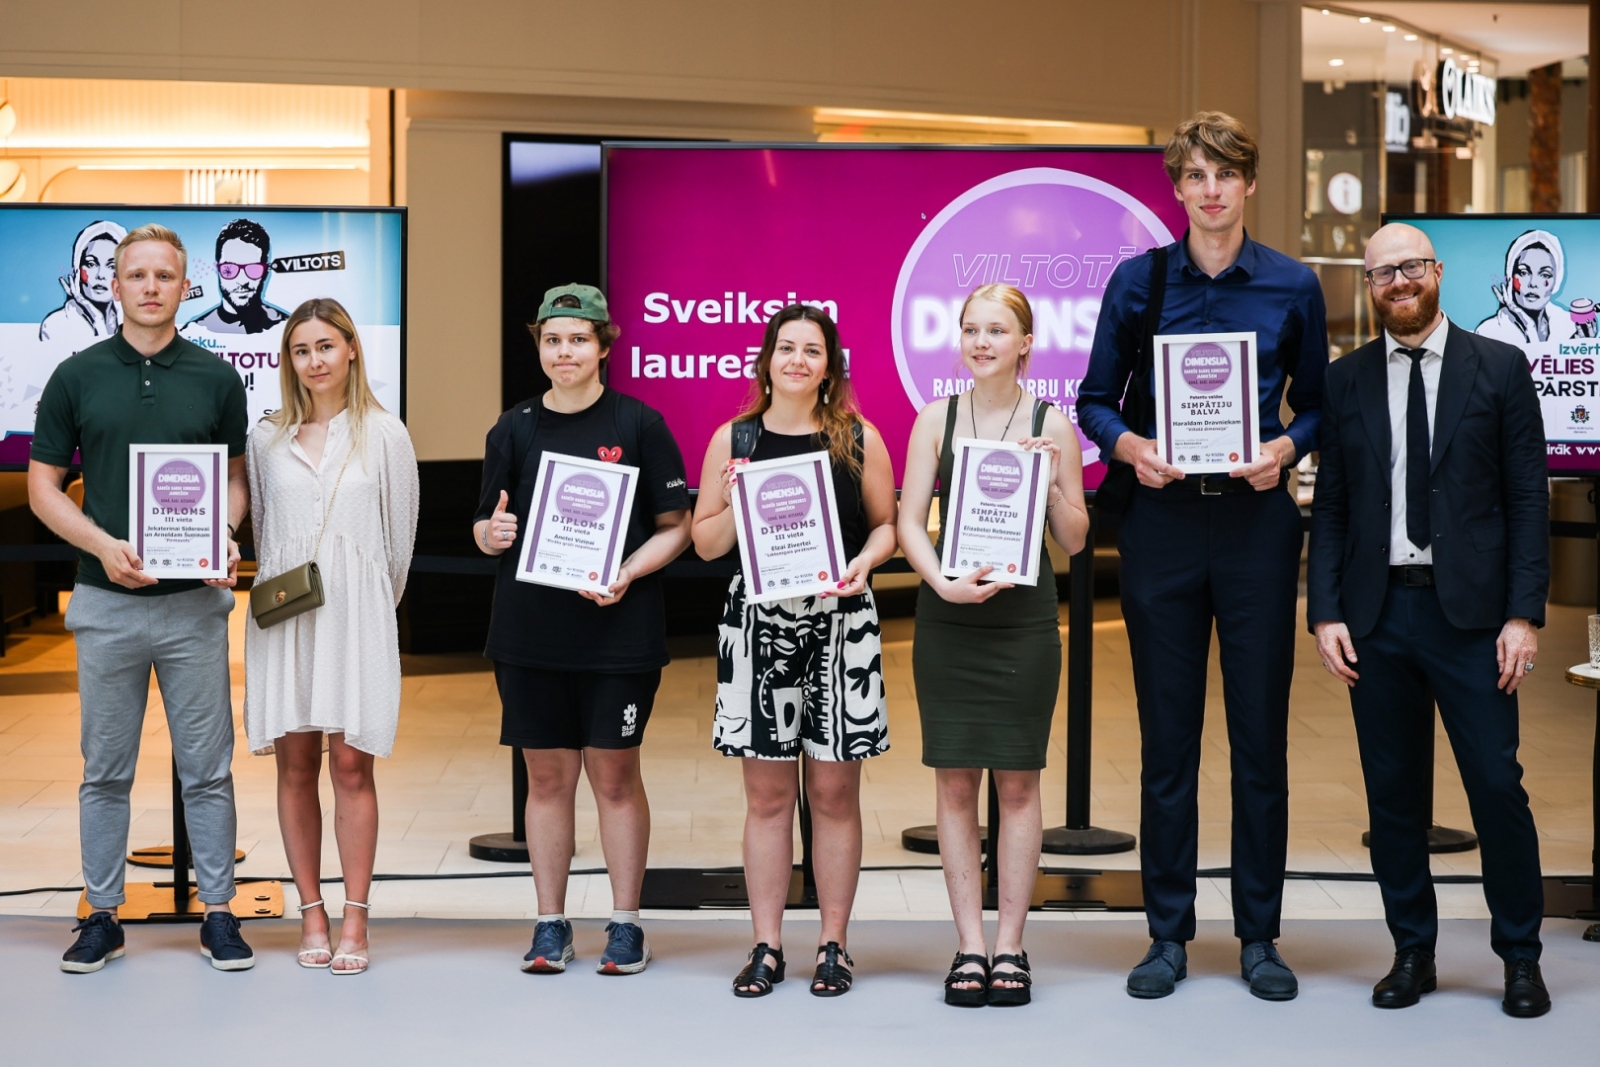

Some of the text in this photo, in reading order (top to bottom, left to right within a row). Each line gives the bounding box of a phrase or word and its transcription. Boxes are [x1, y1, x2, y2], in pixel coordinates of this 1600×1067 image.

[281, 254, 341, 271] VILTOTS
[631, 347, 850, 383] laureā!
[1528, 355, 1595, 375] VĒLIES
[1533, 376, 1600, 397] PĀRST
[1181, 400, 1232, 409] SIMPĀTIJU
[152, 507, 206, 516] DIPLOMS
[971, 508, 1018, 519] SIMPĀTIJU
[552, 514, 605, 531] DIPLOMS
[978, 515, 1006, 524] BALVA
[760, 519, 816, 535] DIPLOMS
[963, 525, 991, 533] Elizabetei
[554, 533, 574, 541] Anetei
[775, 531, 804, 541] III vieta
